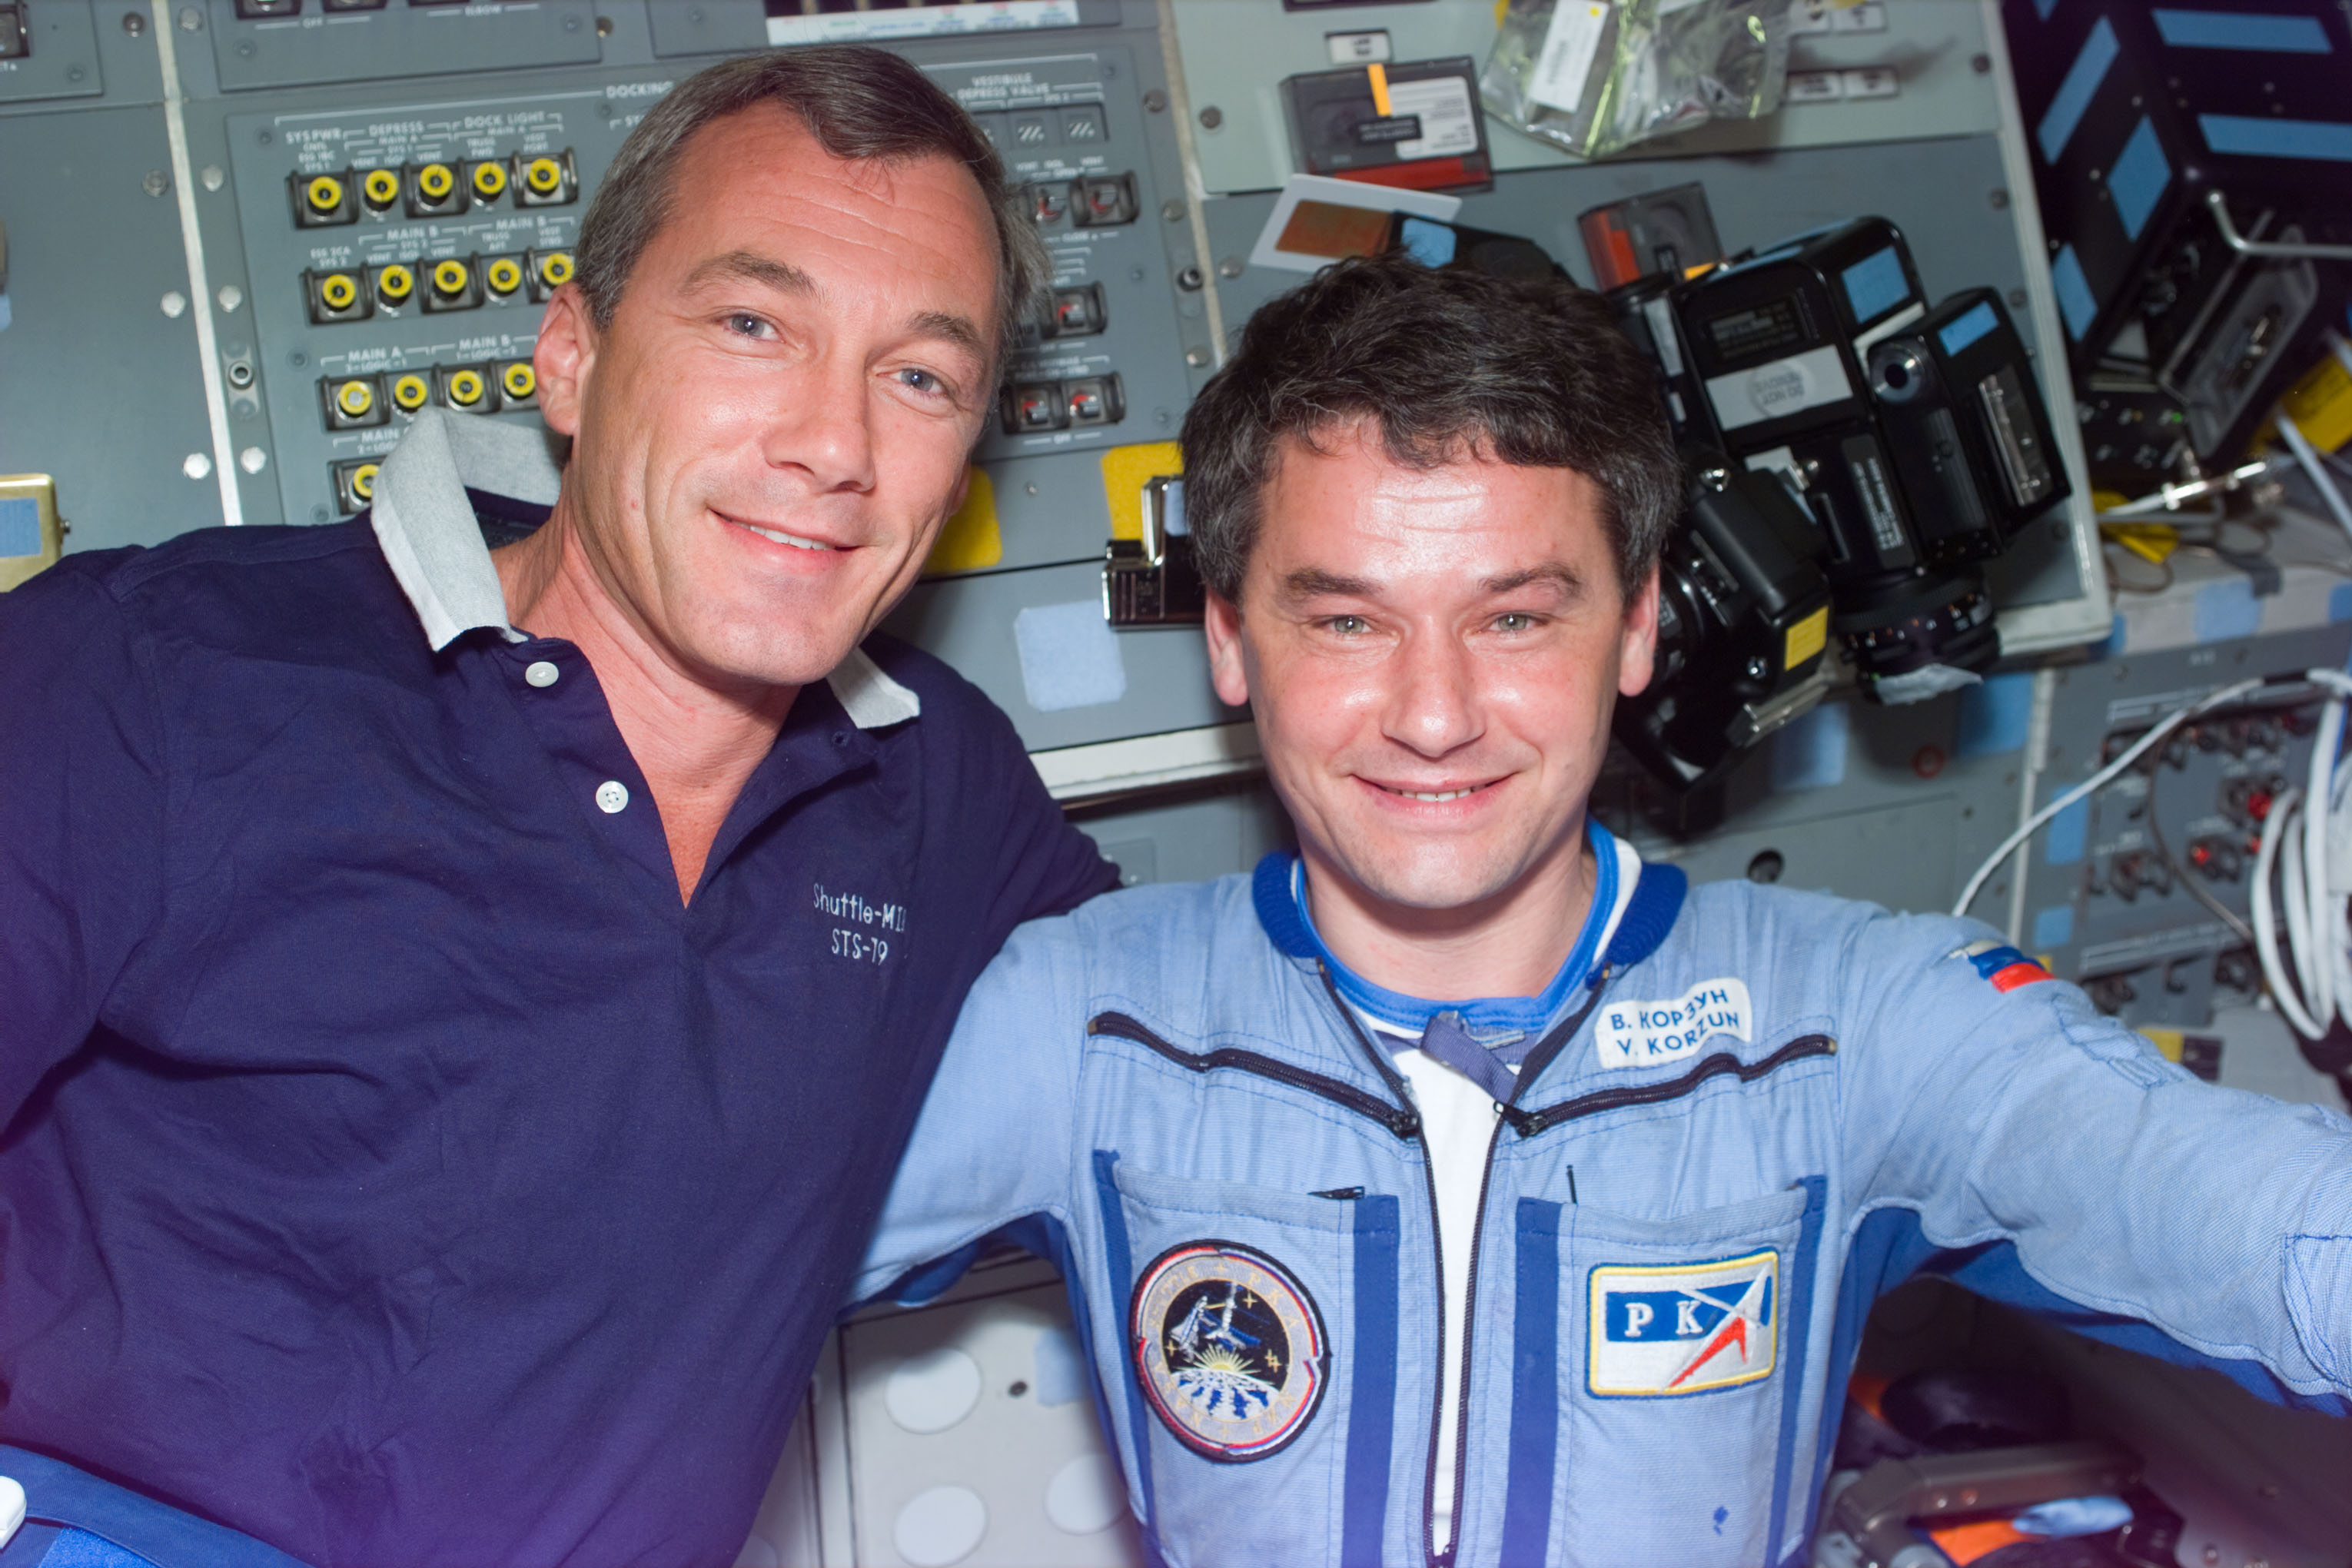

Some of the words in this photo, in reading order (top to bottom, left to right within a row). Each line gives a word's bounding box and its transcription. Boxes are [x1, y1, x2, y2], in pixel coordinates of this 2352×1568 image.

[464, 115, 503, 129] DOCK
[507, 111, 545, 125] LIGHT
[369, 121, 424, 137] DEPRESS
[496, 218, 533, 230] MAIN
[387, 229, 425, 241] MAIN
[459, 337, 498, 350] MAIN
[501, 334, 512, 347] B
[347, 349, 387, 363] MAIN
[390, 345, 403, 358] A
[361, 428, 399, 443] MAIN
[831, 928, 888, 966] STS-79
[1639, 989, 1729, 1029] КОРЗУН
[1646, 1012, 1740, 1056] KORZUN
